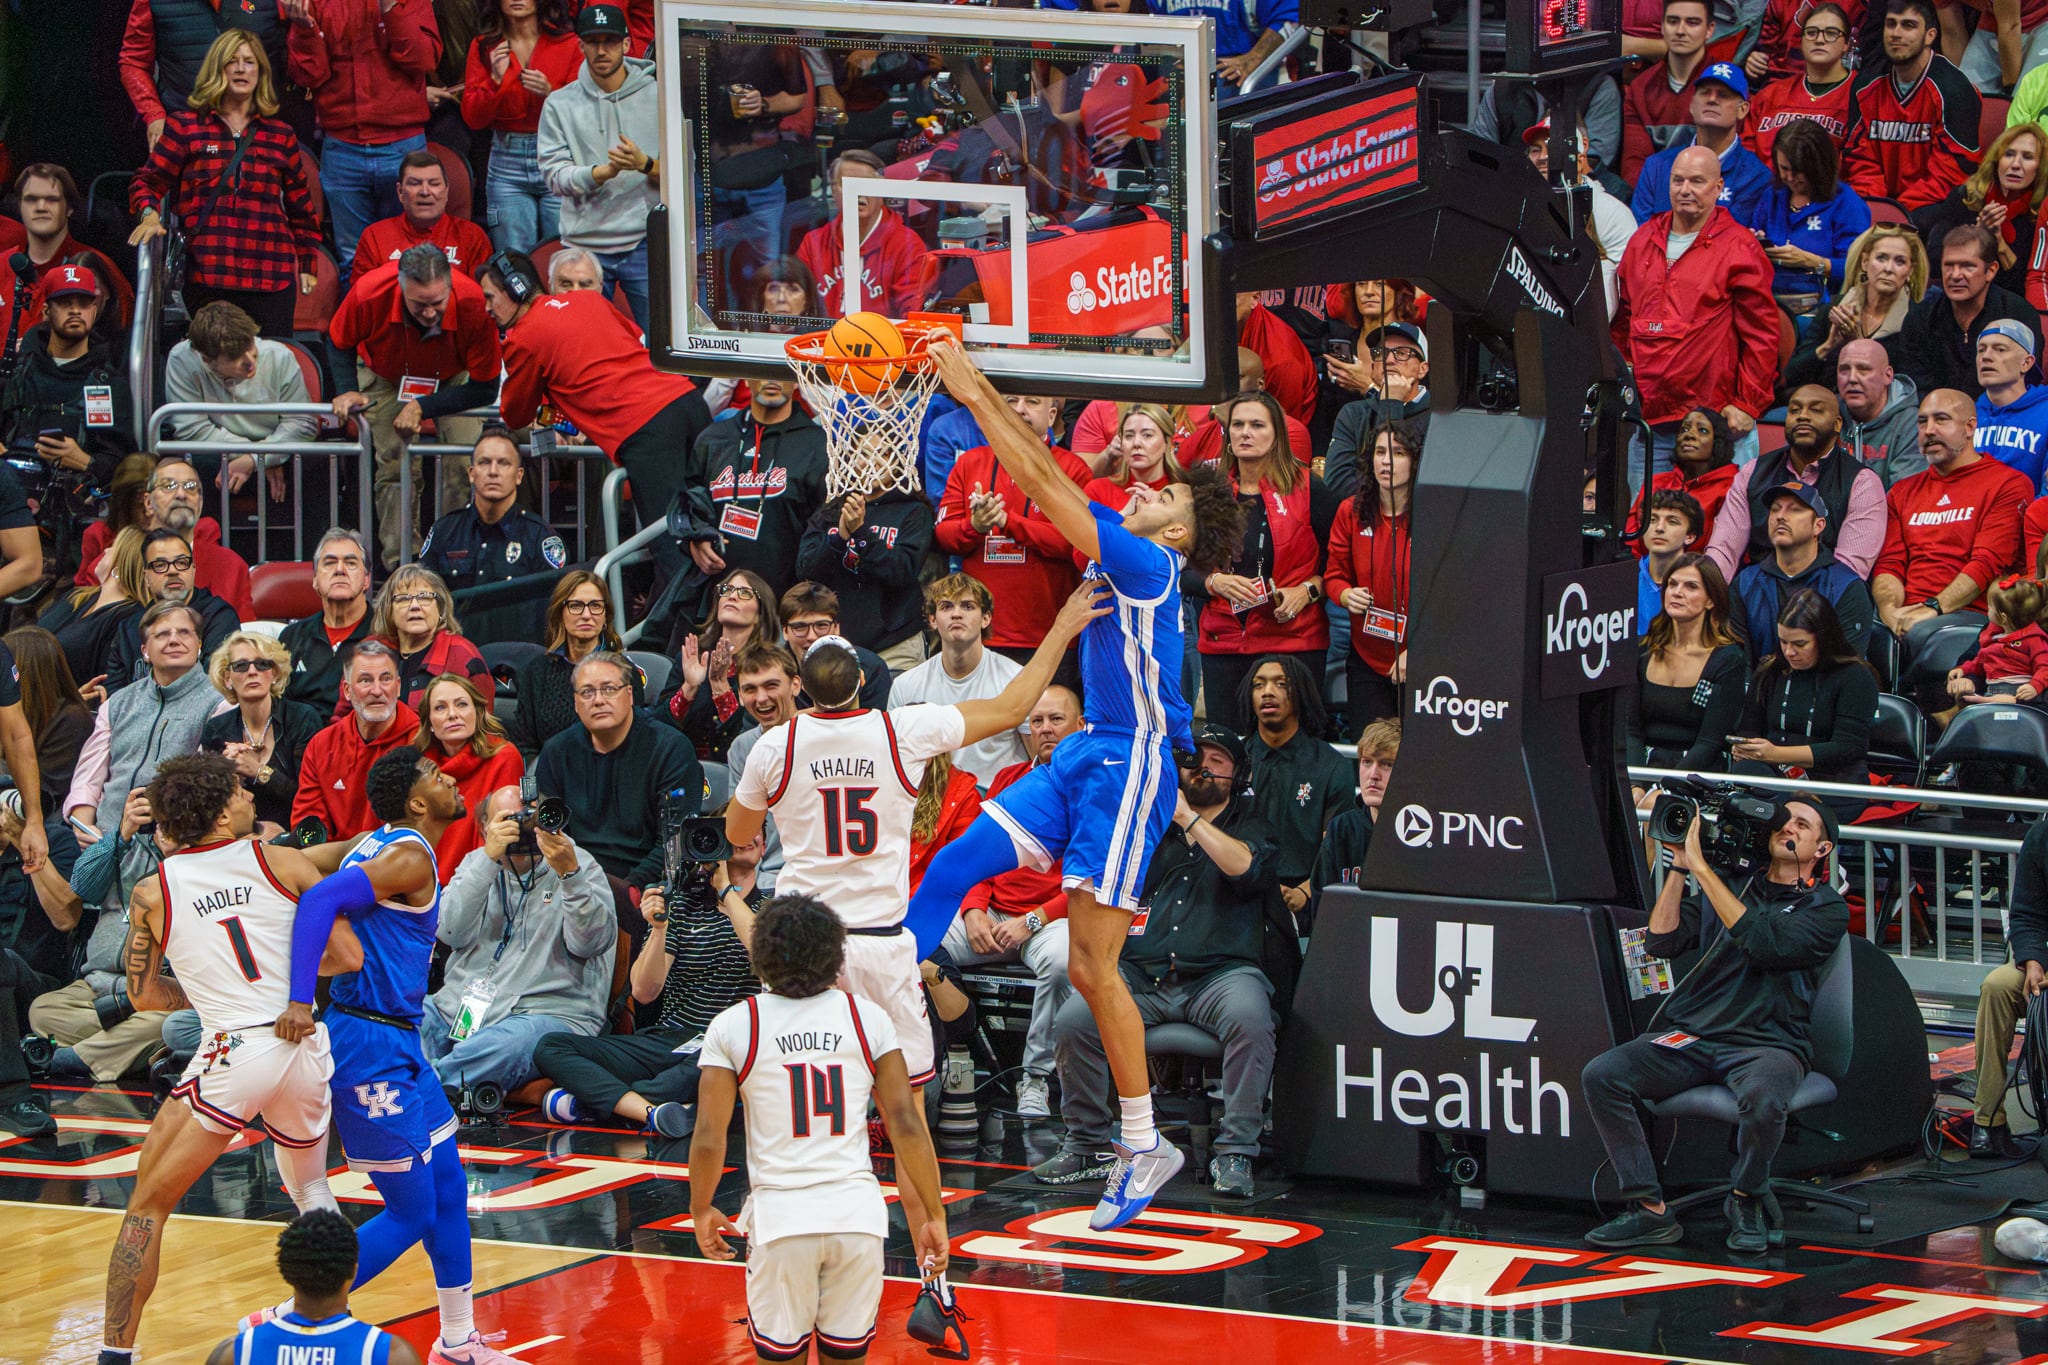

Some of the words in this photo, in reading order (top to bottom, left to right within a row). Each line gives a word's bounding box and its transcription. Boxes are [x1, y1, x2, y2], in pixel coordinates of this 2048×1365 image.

[594, 8, 608, 24] LA
[63, 267, 81, 283] L
[688, 336, 741, 352] SPALDING
[1908, 506, 1975, 526] LOUISVILLE
[1546, 582, 1635, 679] Kroger
[1414, 676, 1508, 736] Kroger
[810, 758, 875, 780] KHALIFA
[817, 786, 879, 857] 15
[1442, 811, 1523, 850] PNC
[193, 886, 252, 918] HADLEY
[215, 915, 263, 983] 1
[775, 1032, 842, 1055] WOOLEY
[354, 1081, 404, 1119] UK
[782, 1063, 845, 1138] 14
[1336, 1044, 1570, 1138] Health
